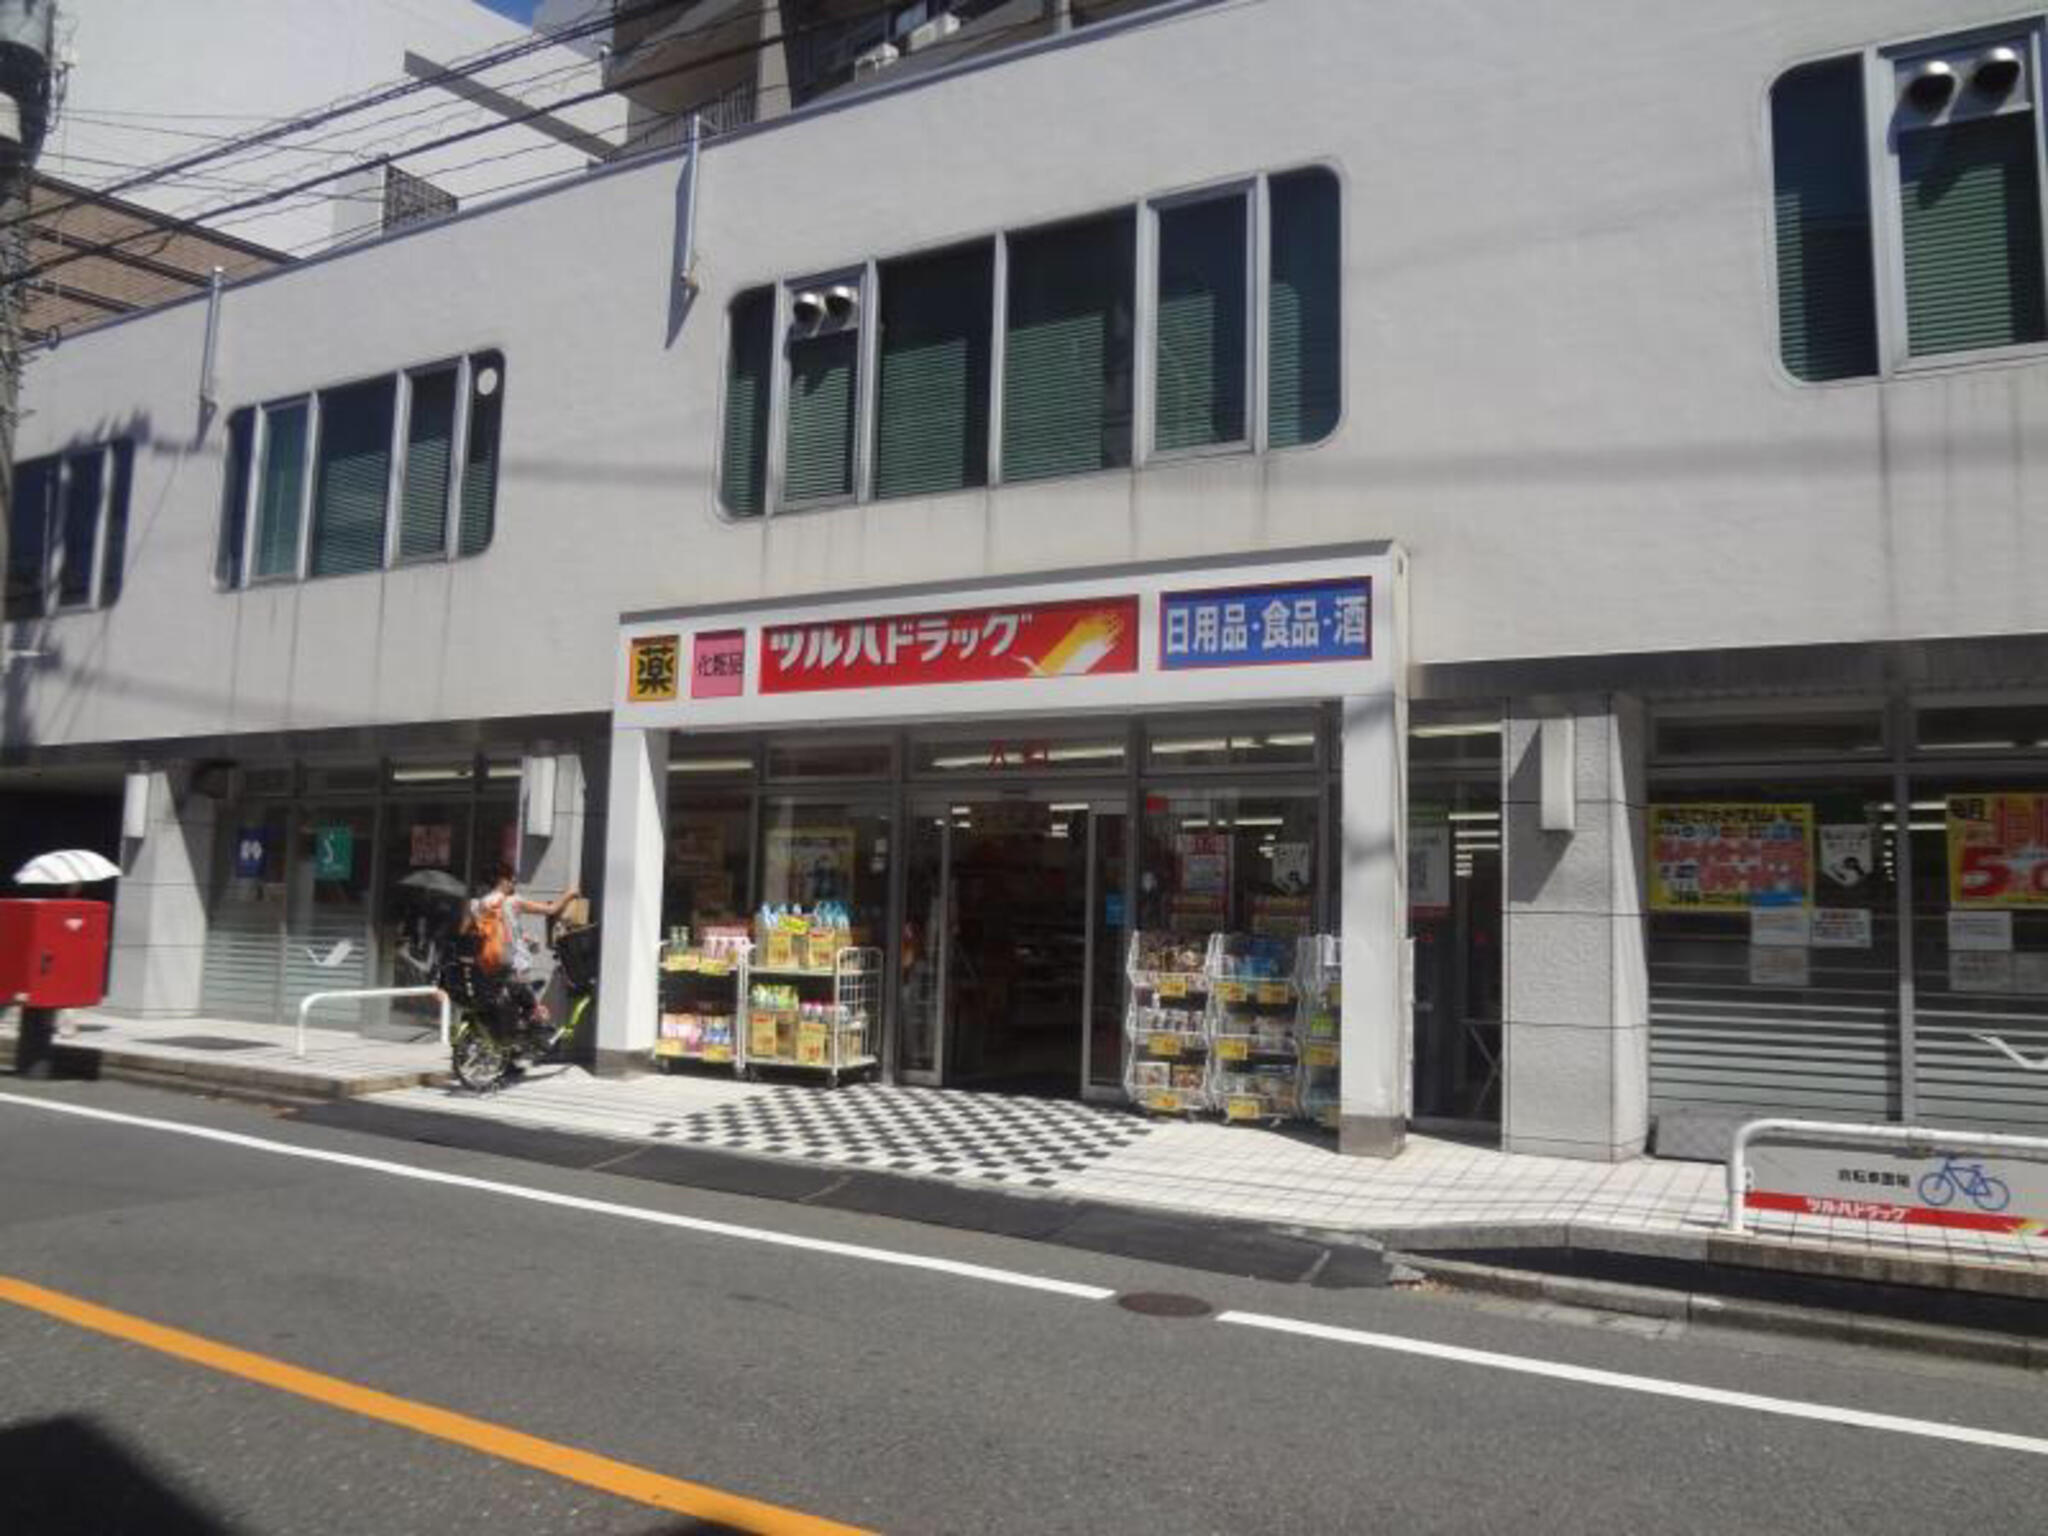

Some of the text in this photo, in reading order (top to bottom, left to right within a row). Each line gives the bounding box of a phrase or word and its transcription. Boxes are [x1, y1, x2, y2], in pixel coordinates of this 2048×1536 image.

[697, 652, 743, 677] 化粧品
[769, 612, 1033, 672] ツルハドラッグ
[636, 645, 675, 695] 薬
